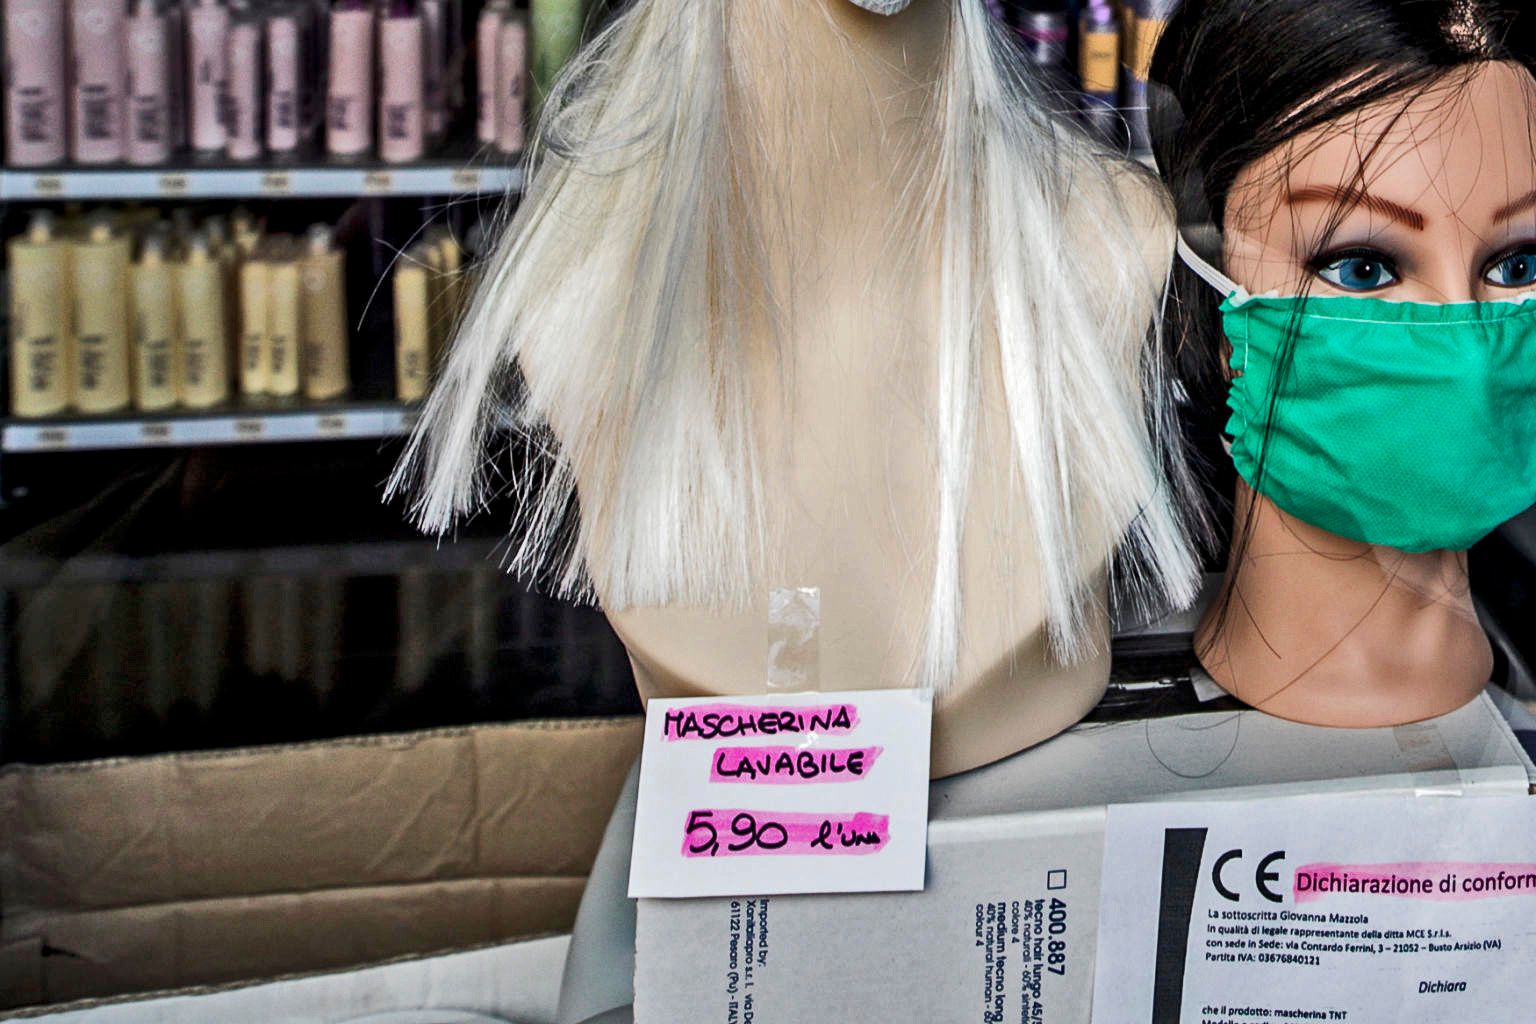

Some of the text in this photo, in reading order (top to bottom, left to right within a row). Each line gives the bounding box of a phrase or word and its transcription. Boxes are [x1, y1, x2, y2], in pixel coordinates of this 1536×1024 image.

[664, 705, 851, 740] MASCHERINA
[716, 750, 865, 780] LAVABILE
[686, 810, 789, 858] 5,90
[1212, 849, 1286, 903] CE
[1296, 872, 1434, 896] Dichiarazione
[1439, 873, 1457, 894] di
[730, 901, 741, 931] 61122
[986, 902, 996, 924] 40%
[1011, 900, 1020, 944] colore 4
[1023, 899, 1033, 921] 40%
[1033, 899, 1045, 936] tecno
[1208, 909, 1369, 924] La sottoscritta Giovanna Mazzola
[975, 904, 984, 947] colour 4
[1047, 897, 1067, 976] 400.887
[1218, 925, 1249, 937] qualità
[1251, 925, 1261, 935] di
[1262, 926, 1288, 938] legale
[1290, 927, 1360, 939] rappresentante
[1361, 929, 1382, 939] della
[1384, 929, 1404, 939] ditta
[1406, 930, 1425, 939] MCE
[729, 933, 739, 970] Pesaro
[985, 926, 995, 963] natural
[1022, 923, 1032, 962] naturali
[1033, 937, 1044, 961] hair
[1206, 940, 1223, 948] con
[1225, 940, 1246, 949] sede
[1248, 940, 1257, 949] in
[1258, 940, 1284, 950] Sede:
[1286, 941, 1299, 950] via
[1301, 942, 1343, 952] Contardo
[1345, 943, 1376, 954] Ferrini,
[1378, 944, 1384, 953] 3
[1393, 944, 1419, 953] 21052
[1429, 943, 1452, 952] Busto
[1453, 941, 1481, 951] Arsizio
[1483, 939, 1502, 951] (VA)
[757, 950, 768, 967] by:
[992, 902, 1007, 1023] medium tecno long
[1205, 952, 1320, 966] Partita IVA: 03676840121
[727, 971, 739, 994] (Pu)
[984, 965, 994, 1003] human
[1022, 970, 1032, 991] 60%
[1029, 963, 1043, 999] lungo
[1418, 980, 1467, 994] Dichiara
[744, 994, 754, 1010] via
[1202, 1005, 1347, 1020] che il prodotto: mascherina TNT
[983, 1010, 993, 1024] 60
